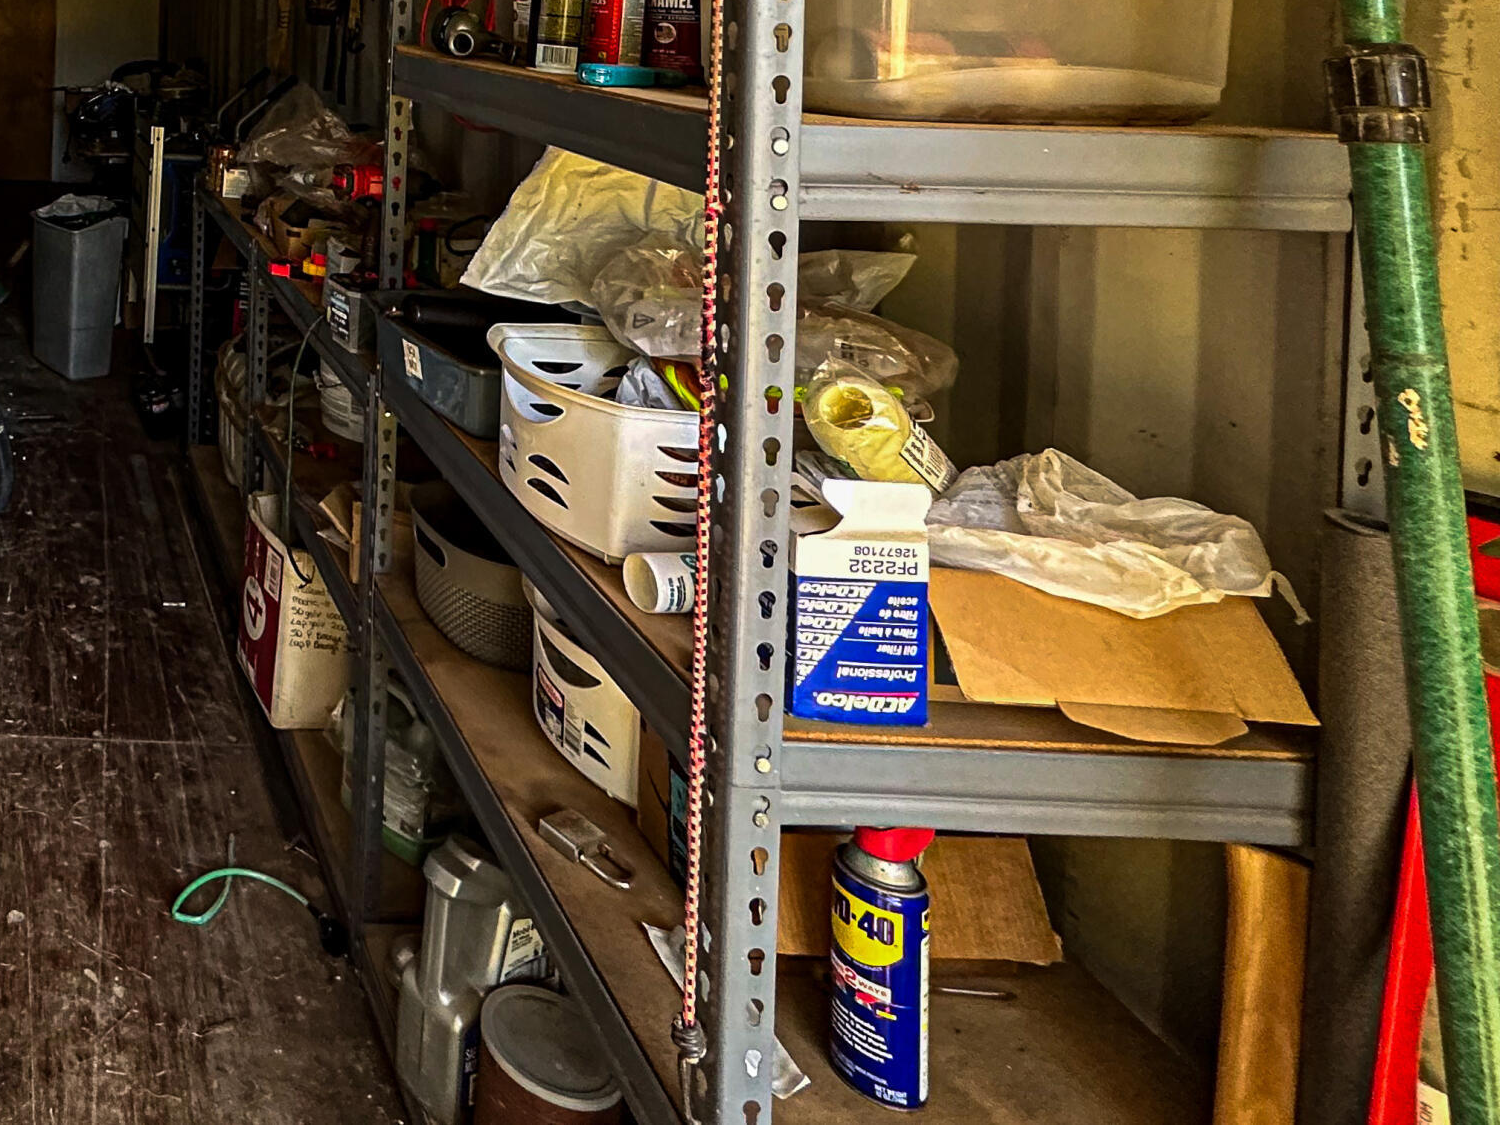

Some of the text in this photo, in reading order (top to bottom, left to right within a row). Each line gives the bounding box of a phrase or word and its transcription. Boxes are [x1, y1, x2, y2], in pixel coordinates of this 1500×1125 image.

[854, 546, 918, 558] 12677108
[849, 558, 918, 575] PF2232
[798, 582, 874, 597] ACDelco
[876, 644, 918, 656] Oil Filter
[837, 666, 917, 682] Professional
[816, 692, 917, 713] ACDelco
